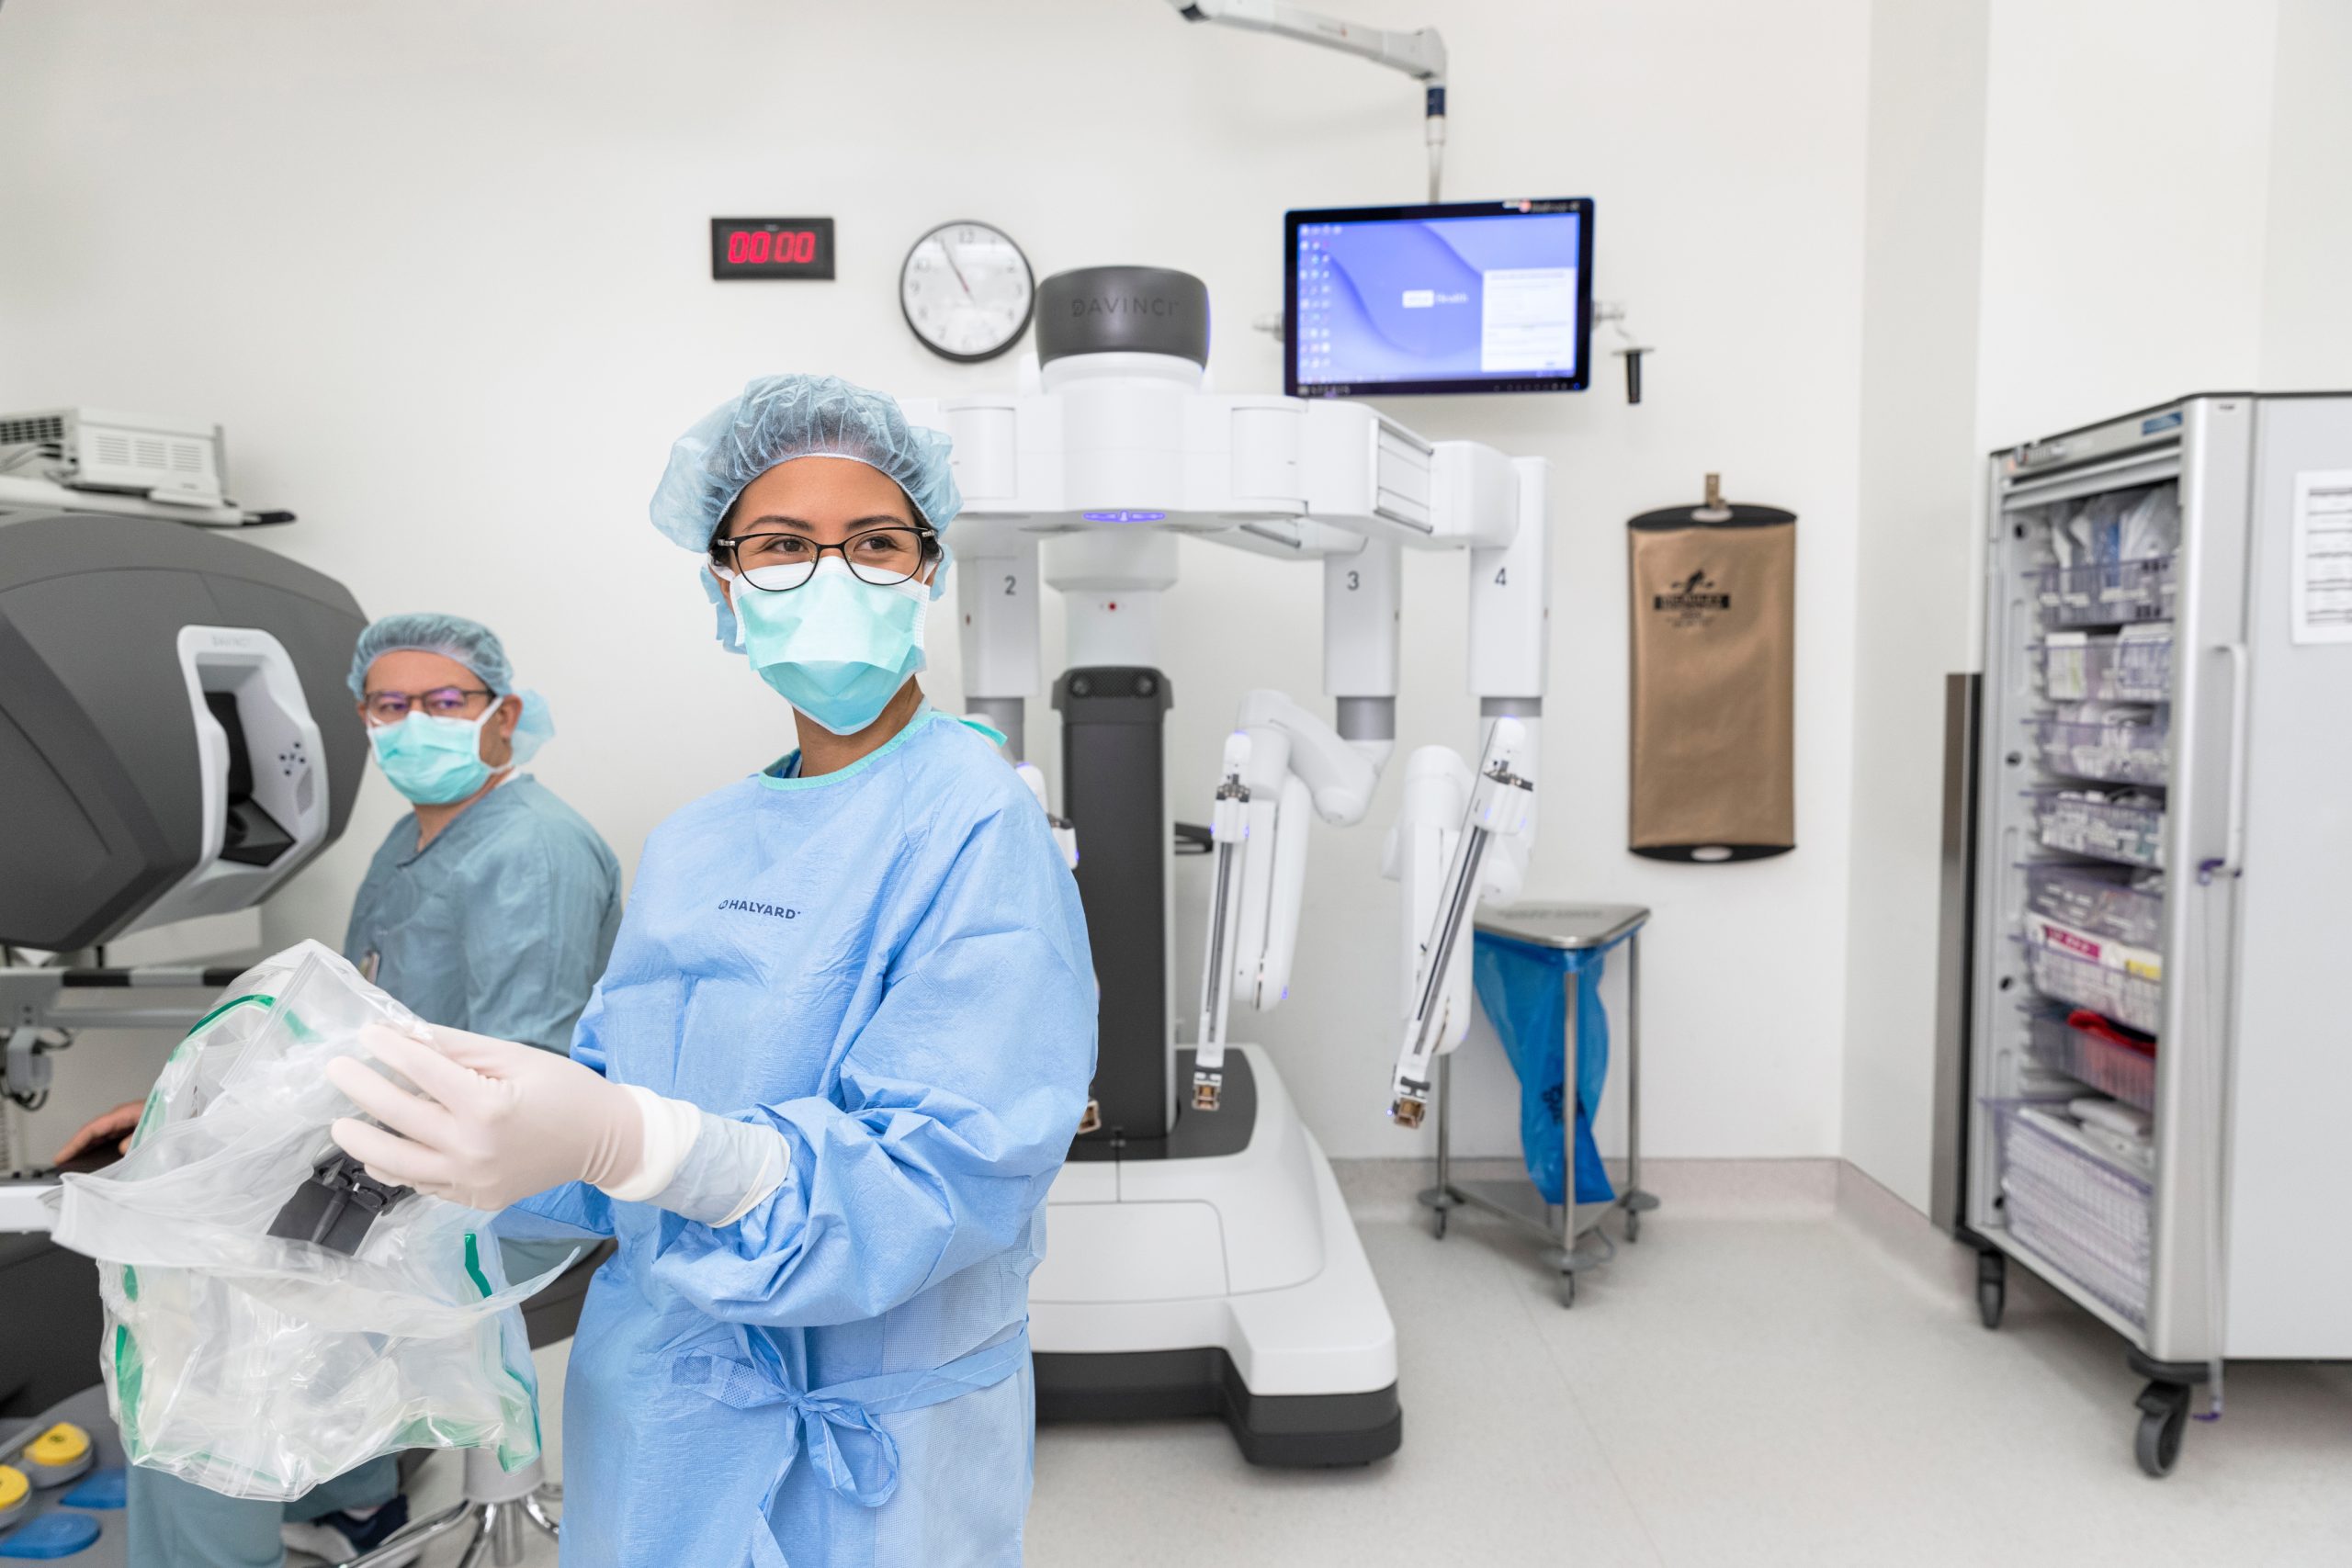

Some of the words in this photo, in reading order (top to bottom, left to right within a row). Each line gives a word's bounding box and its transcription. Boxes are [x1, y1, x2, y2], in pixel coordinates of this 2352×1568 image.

[1004, 575, 1016, 595] 2
[1347, 570, 1359, 591] 3
[1495, 567, 1507, 587] 4
[729, 899, 797, 919] HALYARD
